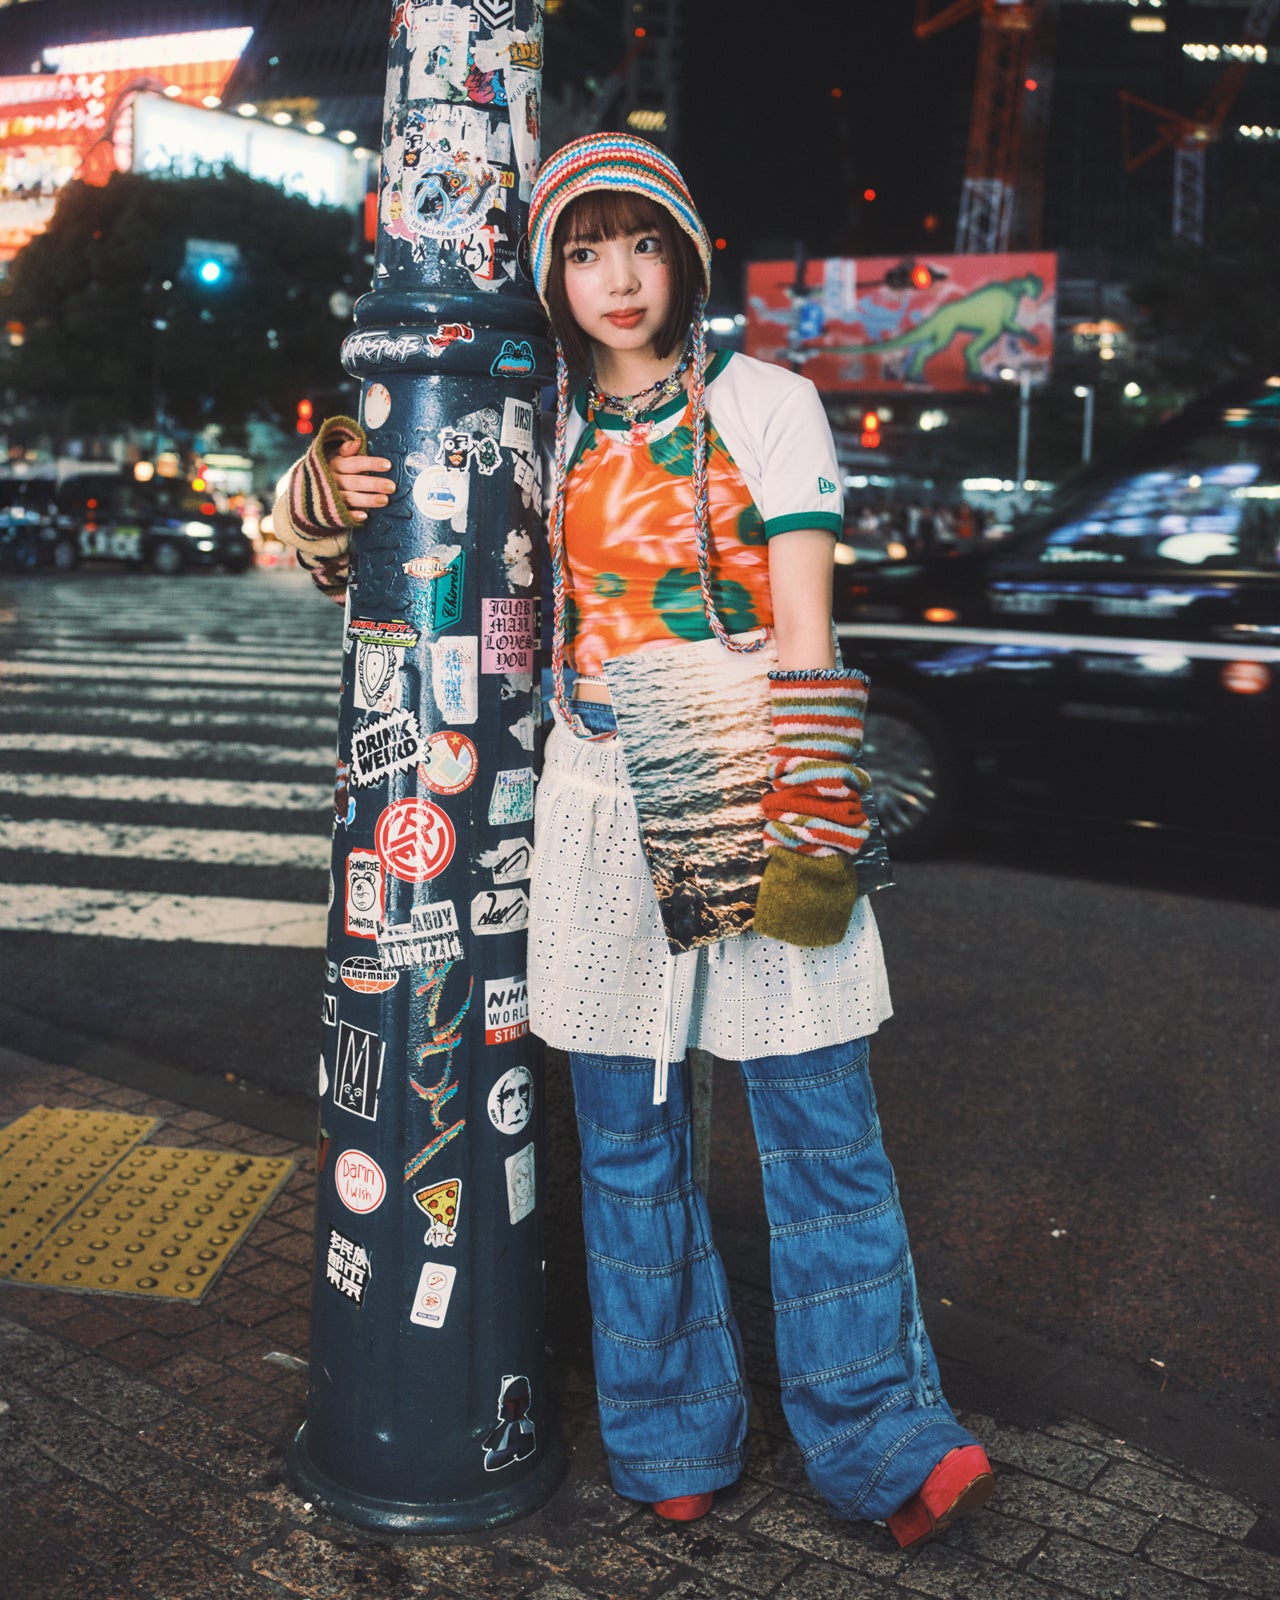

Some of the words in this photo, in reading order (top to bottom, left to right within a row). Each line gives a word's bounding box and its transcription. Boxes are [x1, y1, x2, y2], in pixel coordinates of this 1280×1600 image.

[488, 600, 531, 617] JUNK
[489, 617, 530, 633] MAIL
[484, 635, 534, 650] LOVES
[495, 652, 527, 671] YOU
[355, 719, 412, 758] DRINK
[357, 738, 418, 776] WEIRD
[343, 1159, 375, 1185] Damn
[350, 1187, 372, 1202] wish
